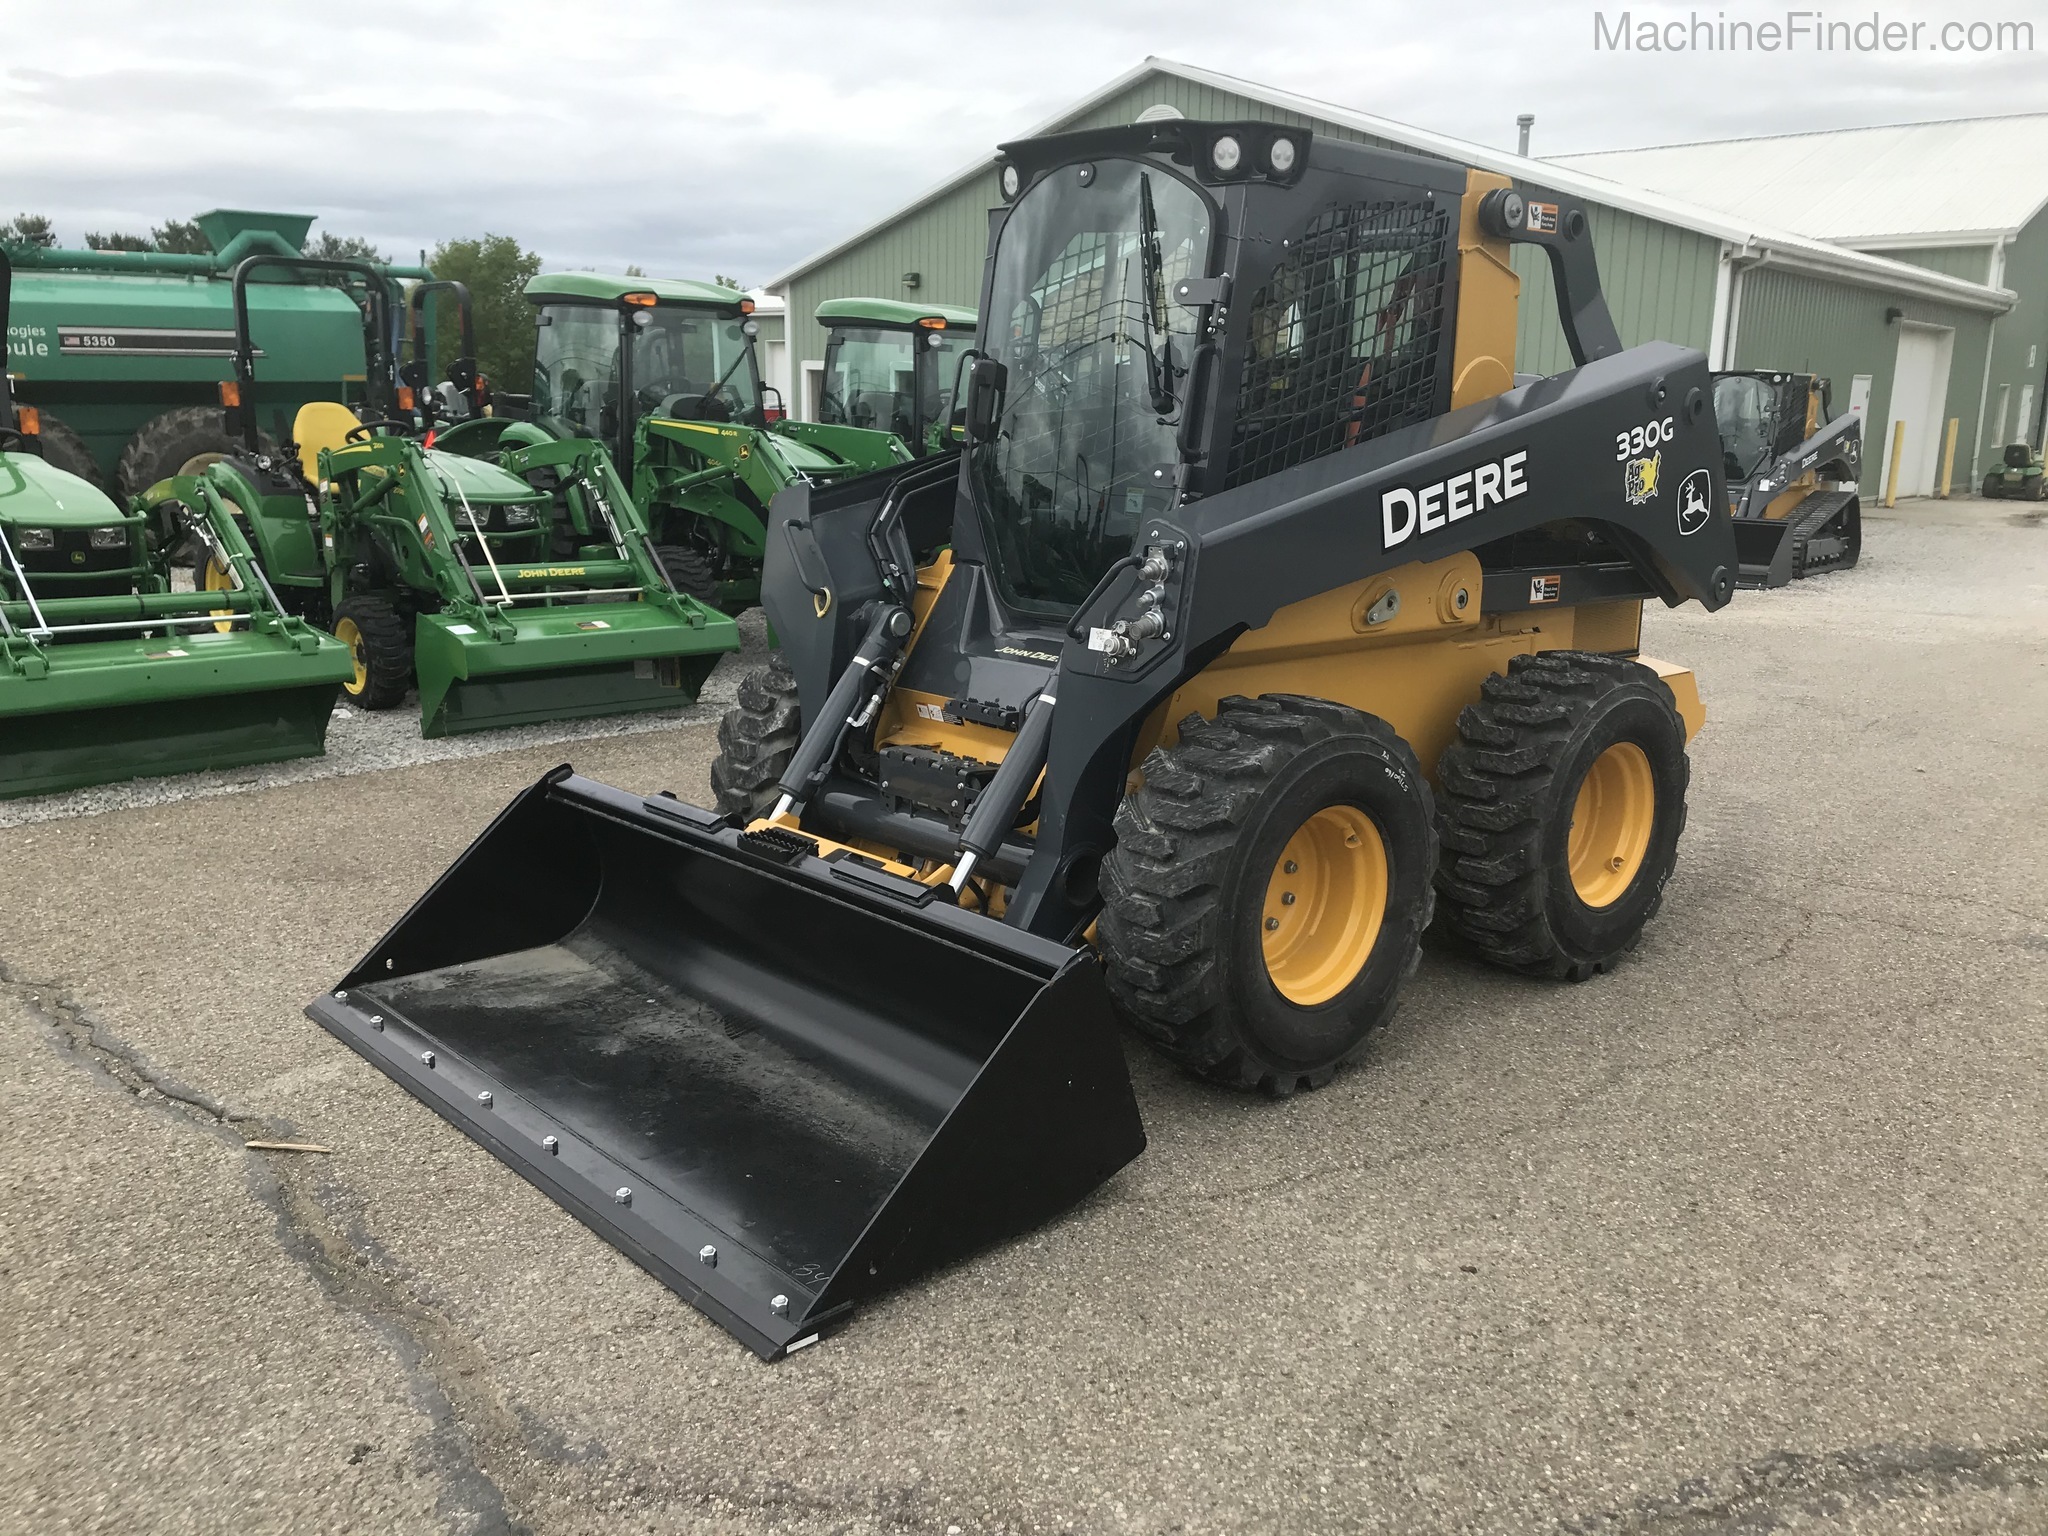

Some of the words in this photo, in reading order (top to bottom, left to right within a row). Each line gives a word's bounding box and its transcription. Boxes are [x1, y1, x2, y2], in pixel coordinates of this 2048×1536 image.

[83, 335, 116, 347] 5350
[1616, 416, 1674, 461] 330G
[1381, 450, 1528, 549] DEERE
[517, 569, 548, 579] JOHN
[548, 567, 586, 577] DEERE
[994, 645, 1033, 657] JOHN
[1029, 651, 1060, 663] DEE
